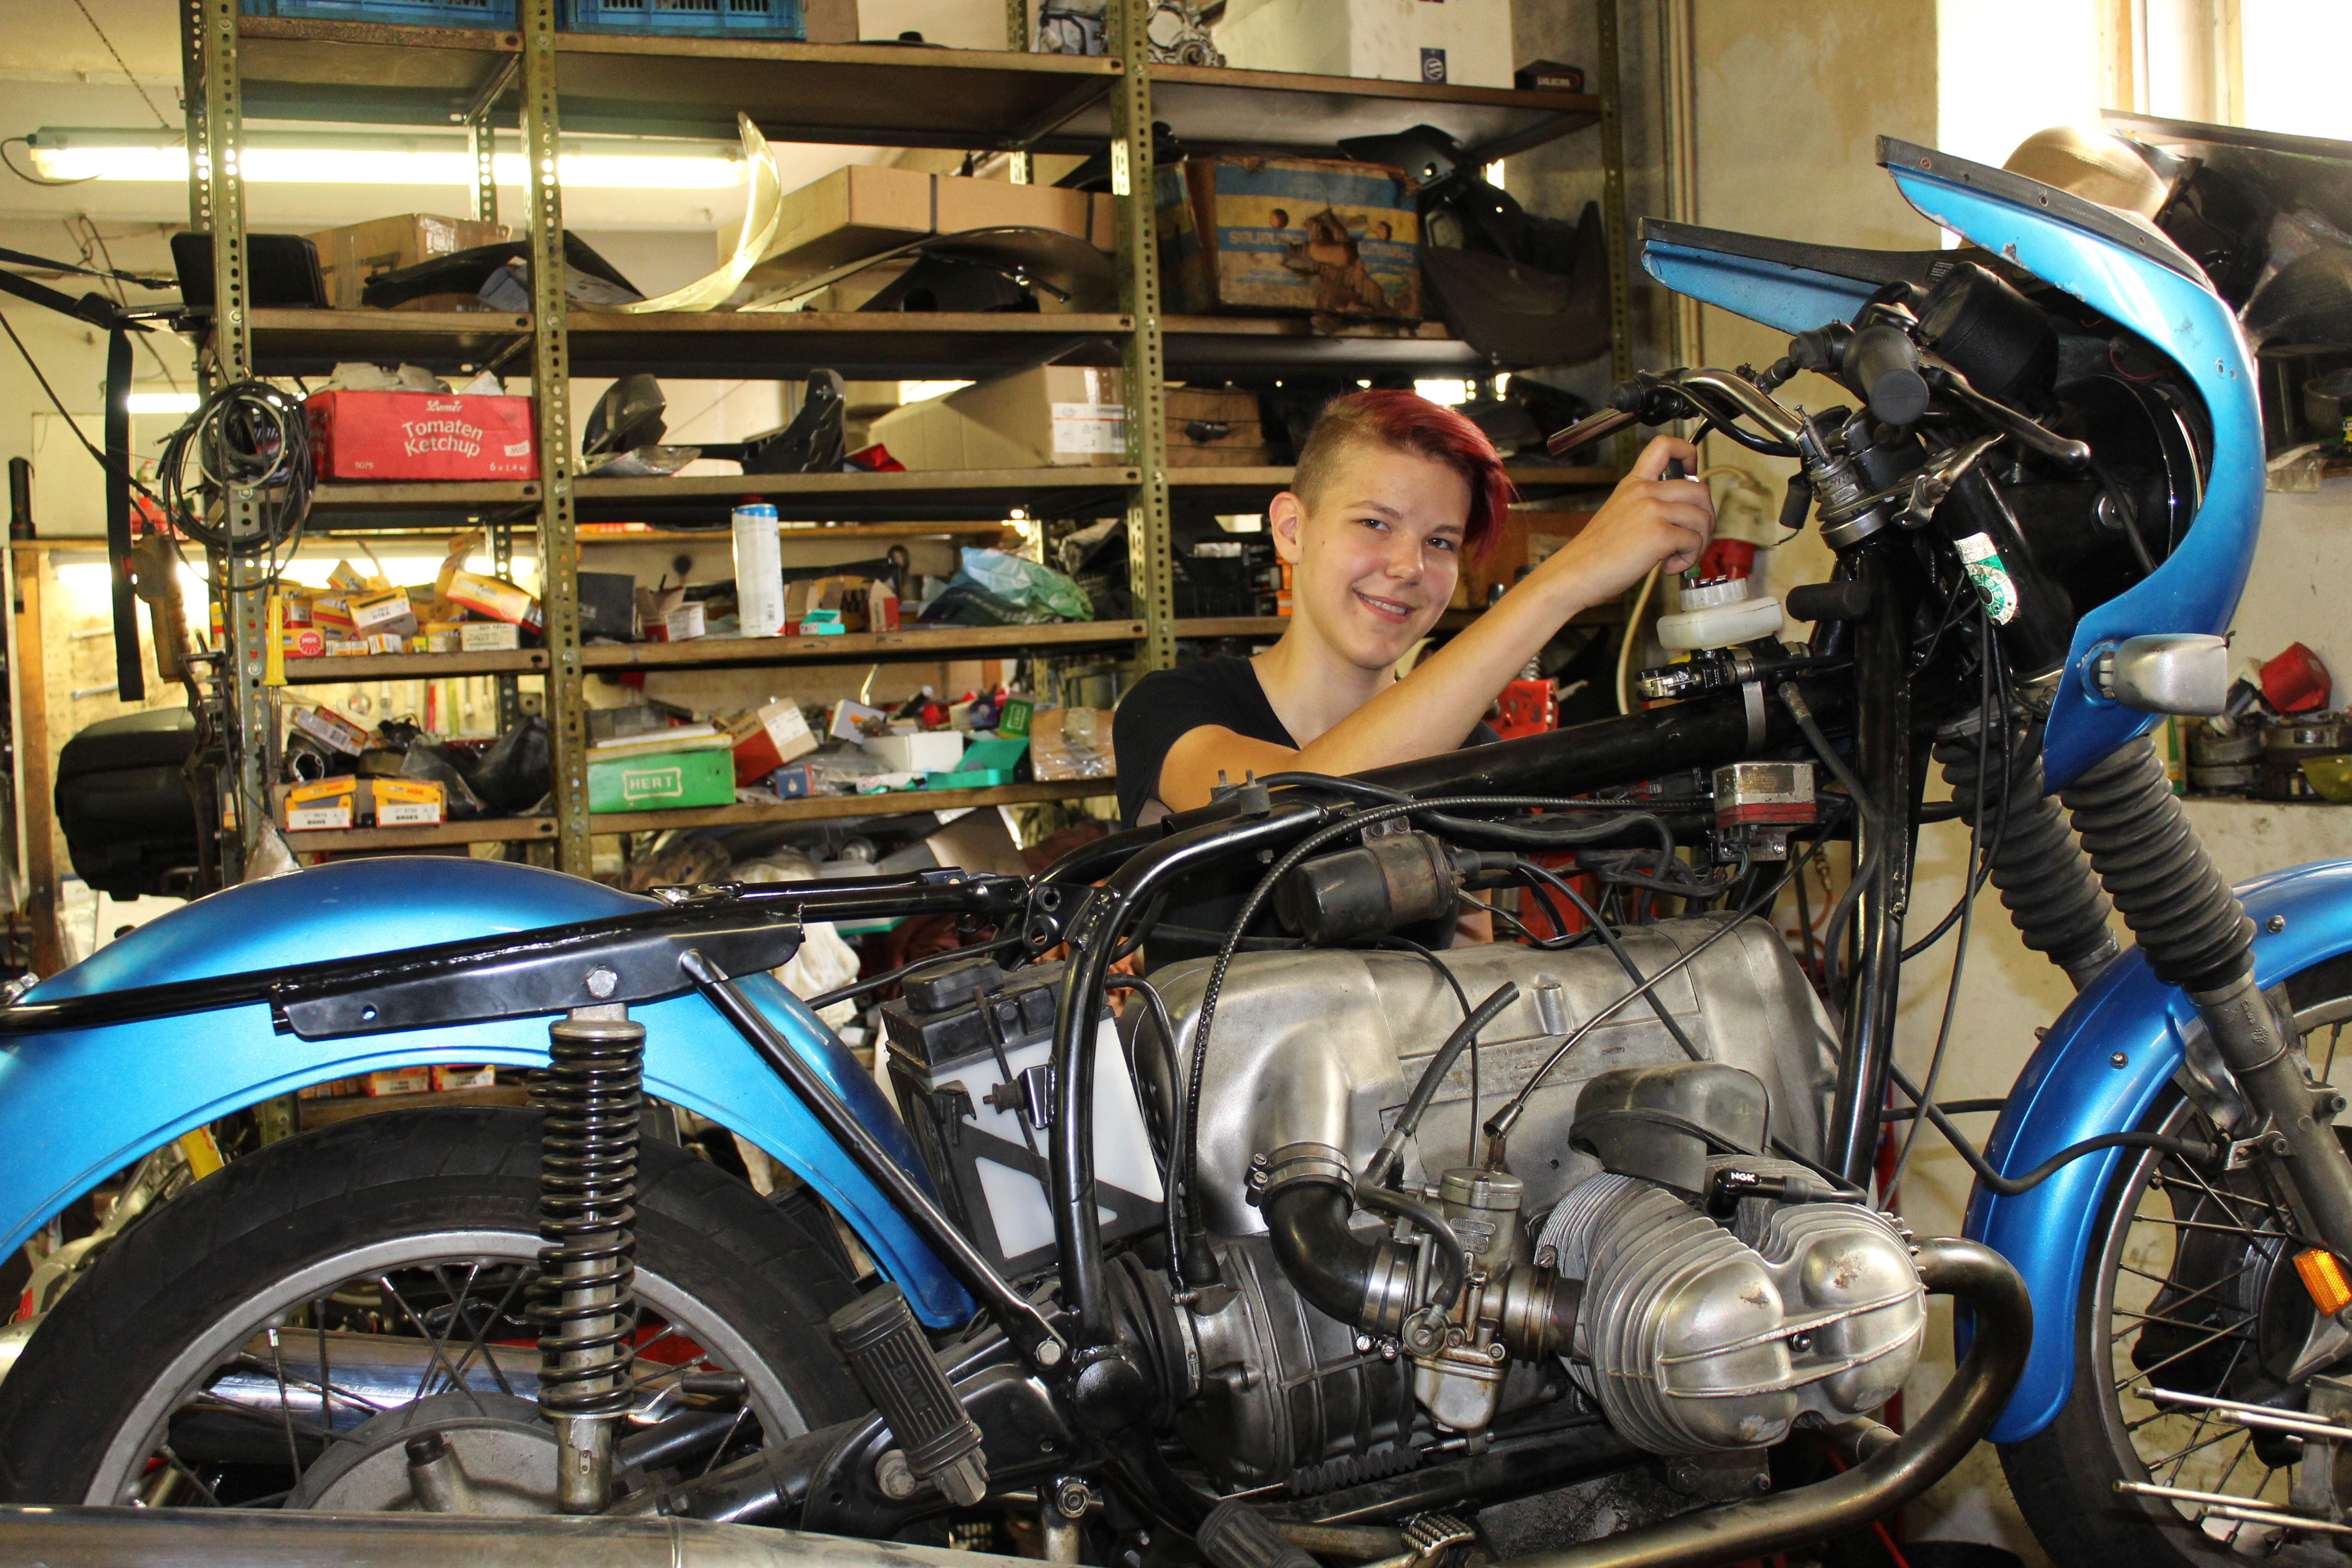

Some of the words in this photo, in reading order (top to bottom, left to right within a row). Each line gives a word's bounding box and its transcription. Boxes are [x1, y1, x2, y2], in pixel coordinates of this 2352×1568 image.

[402, 419, 483, 441] Tomaten
[404, 434, 481, 458] Ketchup
[490, 461, 496, 471] 6
[629, 776, 672, 790] HERT
[1730, 1171, 1756, 1183] NGK
[892, 1363, 929, 1409] BMW
